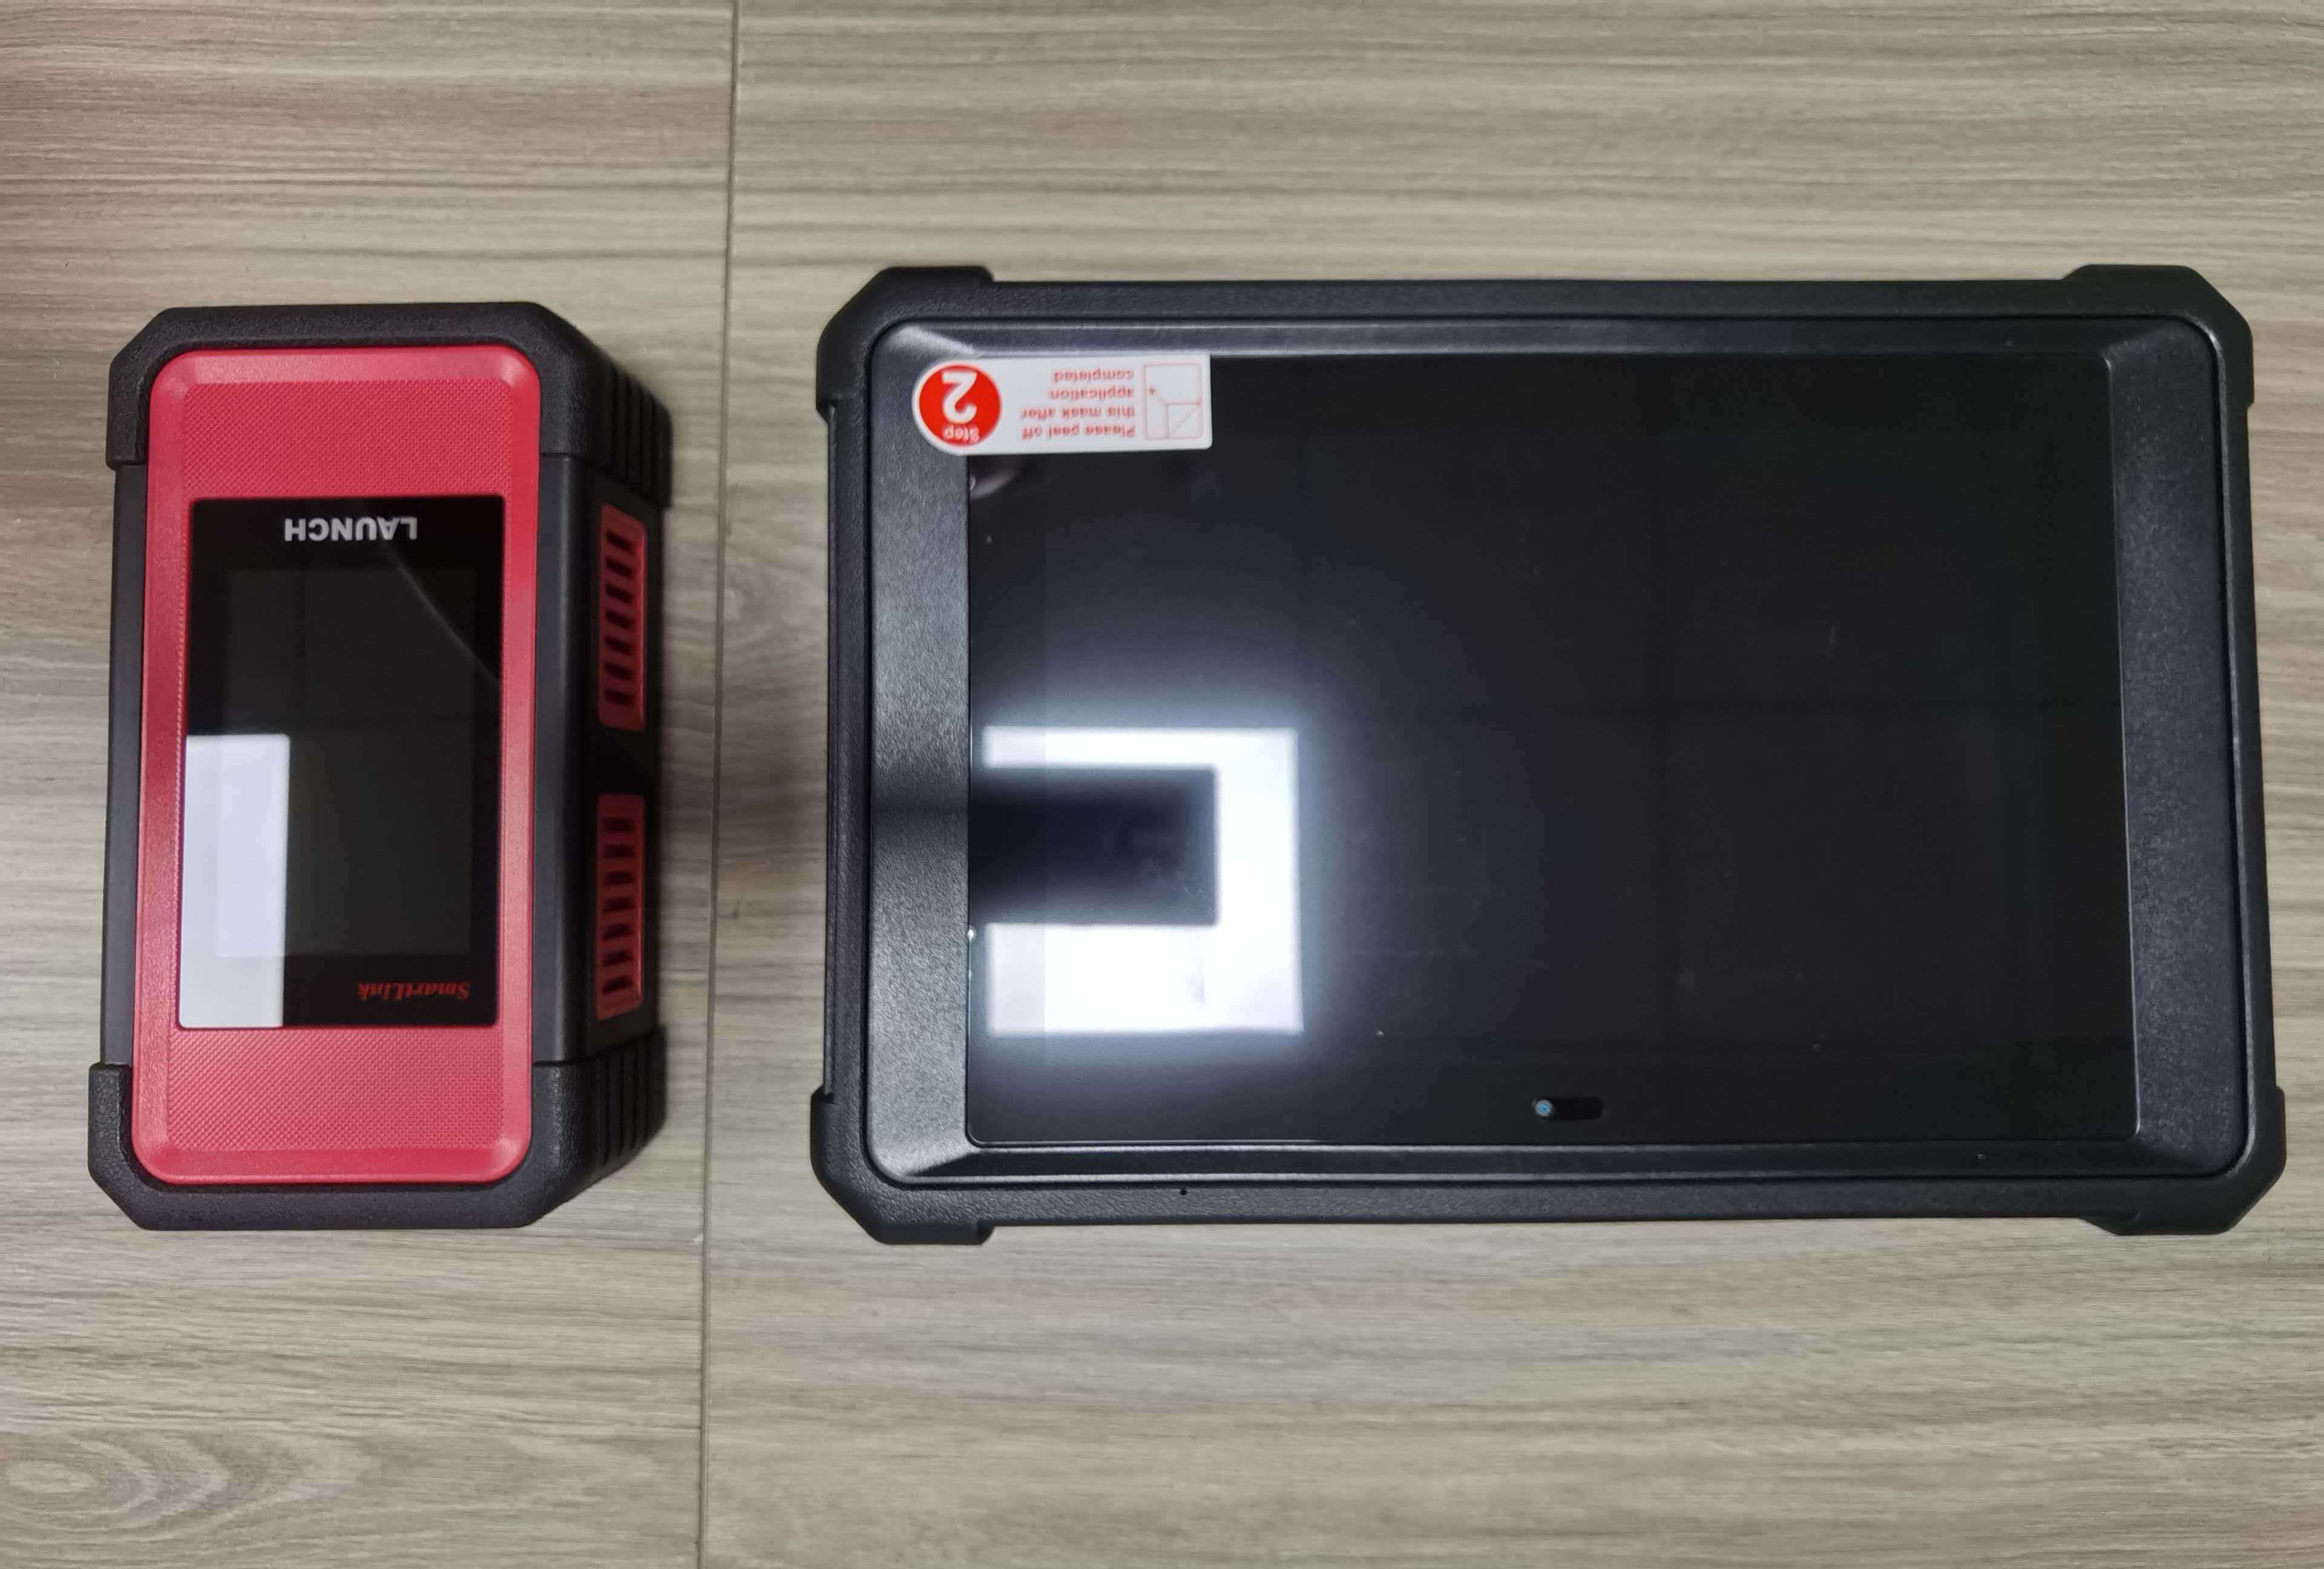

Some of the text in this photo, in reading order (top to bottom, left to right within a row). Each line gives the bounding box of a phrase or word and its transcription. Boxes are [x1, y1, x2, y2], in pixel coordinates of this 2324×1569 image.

[1052, 368, 1134, 383] completed
[942, 372, 978, 424] 2
[1049, 387, 1133, 401] application
[1021, 407, 1135, 421] this mask after
[943, 424, 980, 442] Step
[1021, 424, 1135, 439] Please peel off
[284, 516, 418, 542] LAUNCH
[358, 981, 470, 1001] SmartLink
